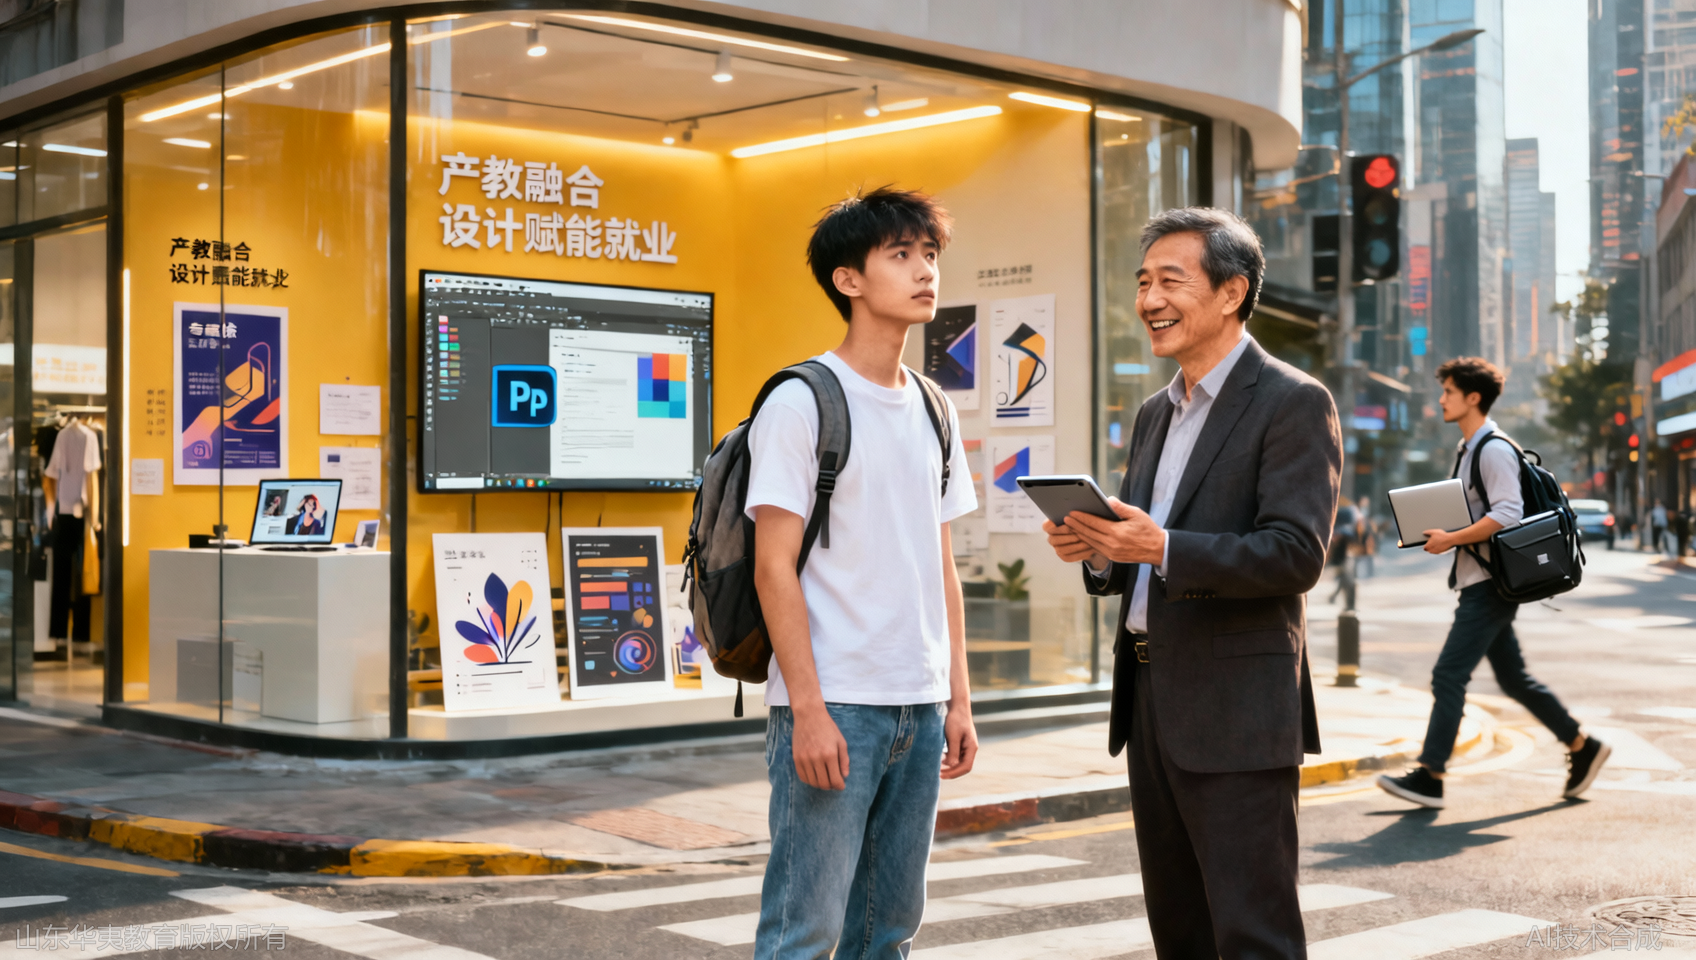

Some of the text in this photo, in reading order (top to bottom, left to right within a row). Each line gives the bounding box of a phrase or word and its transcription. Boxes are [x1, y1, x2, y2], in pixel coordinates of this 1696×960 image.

[438, 152, 604, 209] 产教融合
[438, 202, 678, 264] 设计赋能就业
[510, 380, 548, 418] Pp
